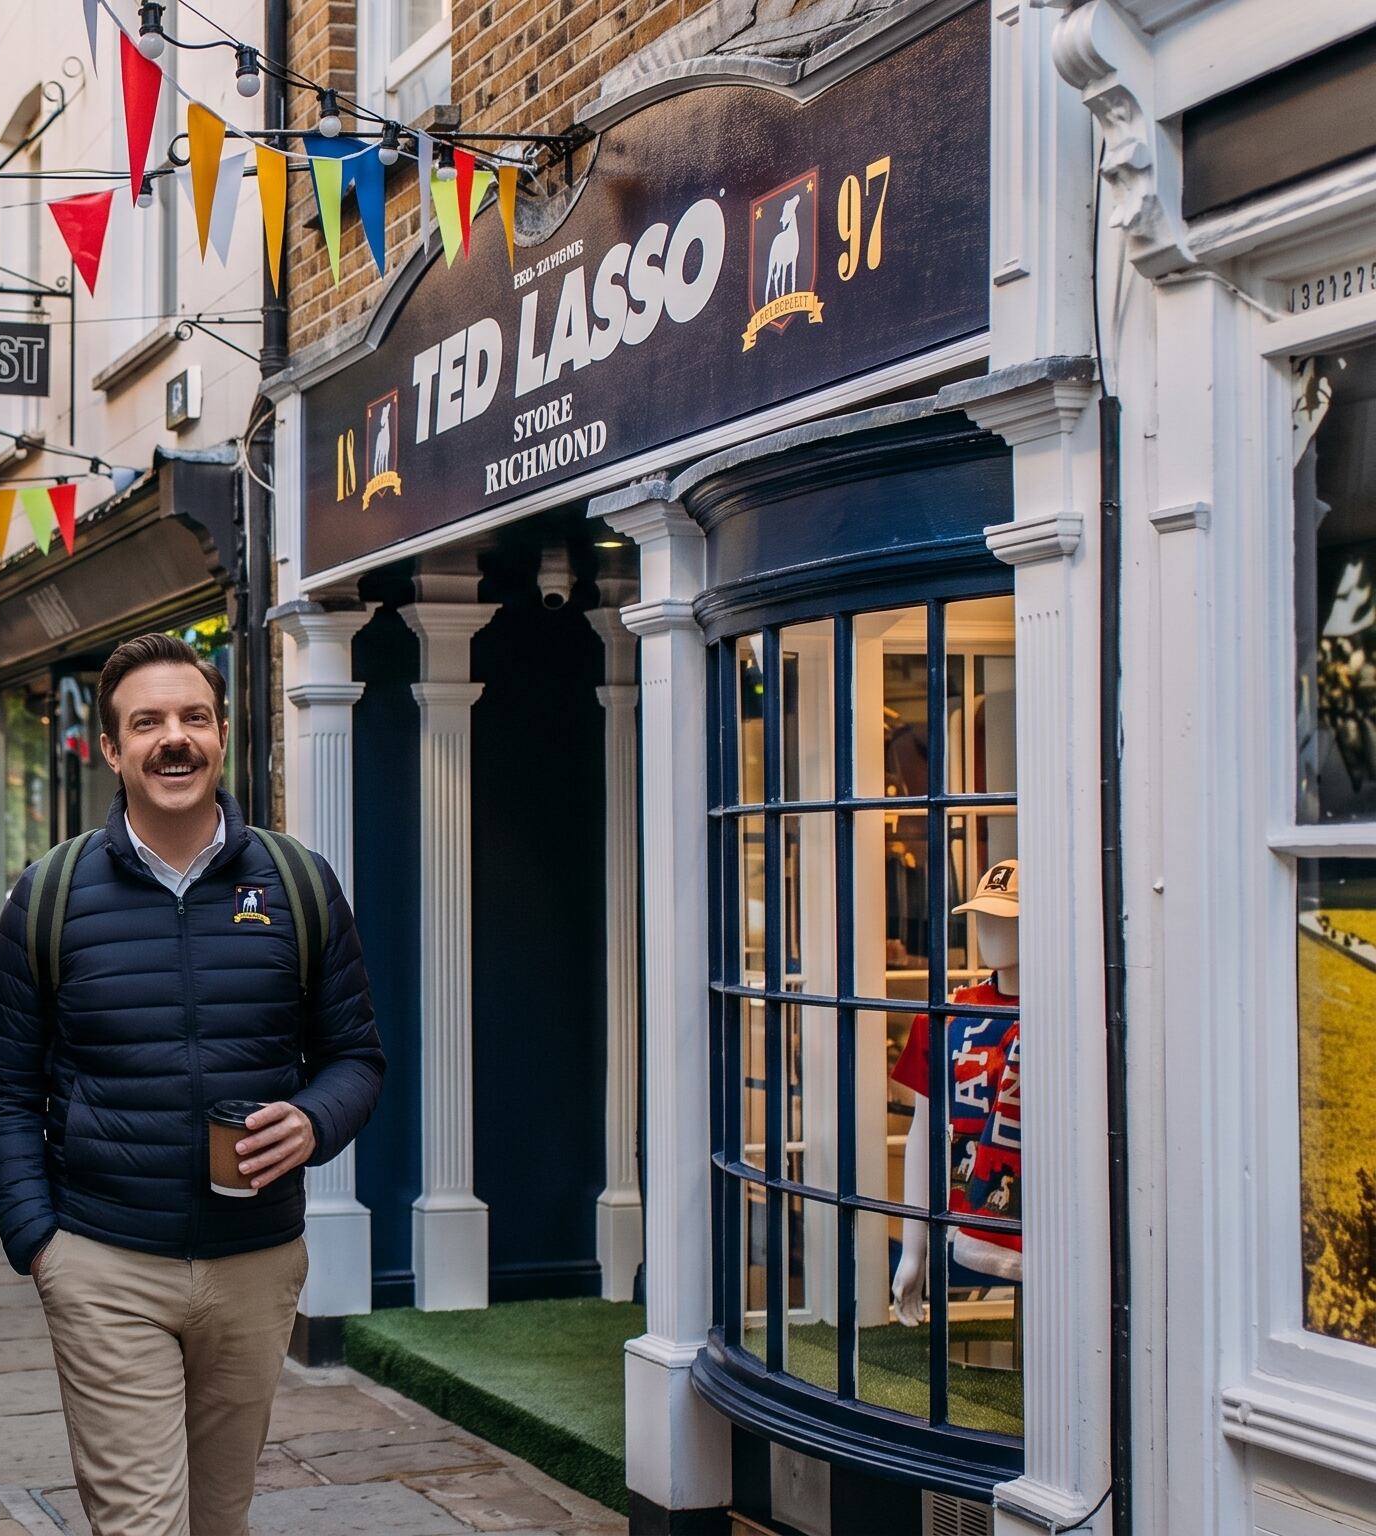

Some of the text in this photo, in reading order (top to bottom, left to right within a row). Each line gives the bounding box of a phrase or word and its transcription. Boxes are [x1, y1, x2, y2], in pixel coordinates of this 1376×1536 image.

[837, 155, 891, 282] 97
[412, 198, 726, 445] TED LASSO
[513, 392, 573, 443] STORE
[336, 428, 356, 502] 18
[484, 420, 607, 496] RICHMOND
